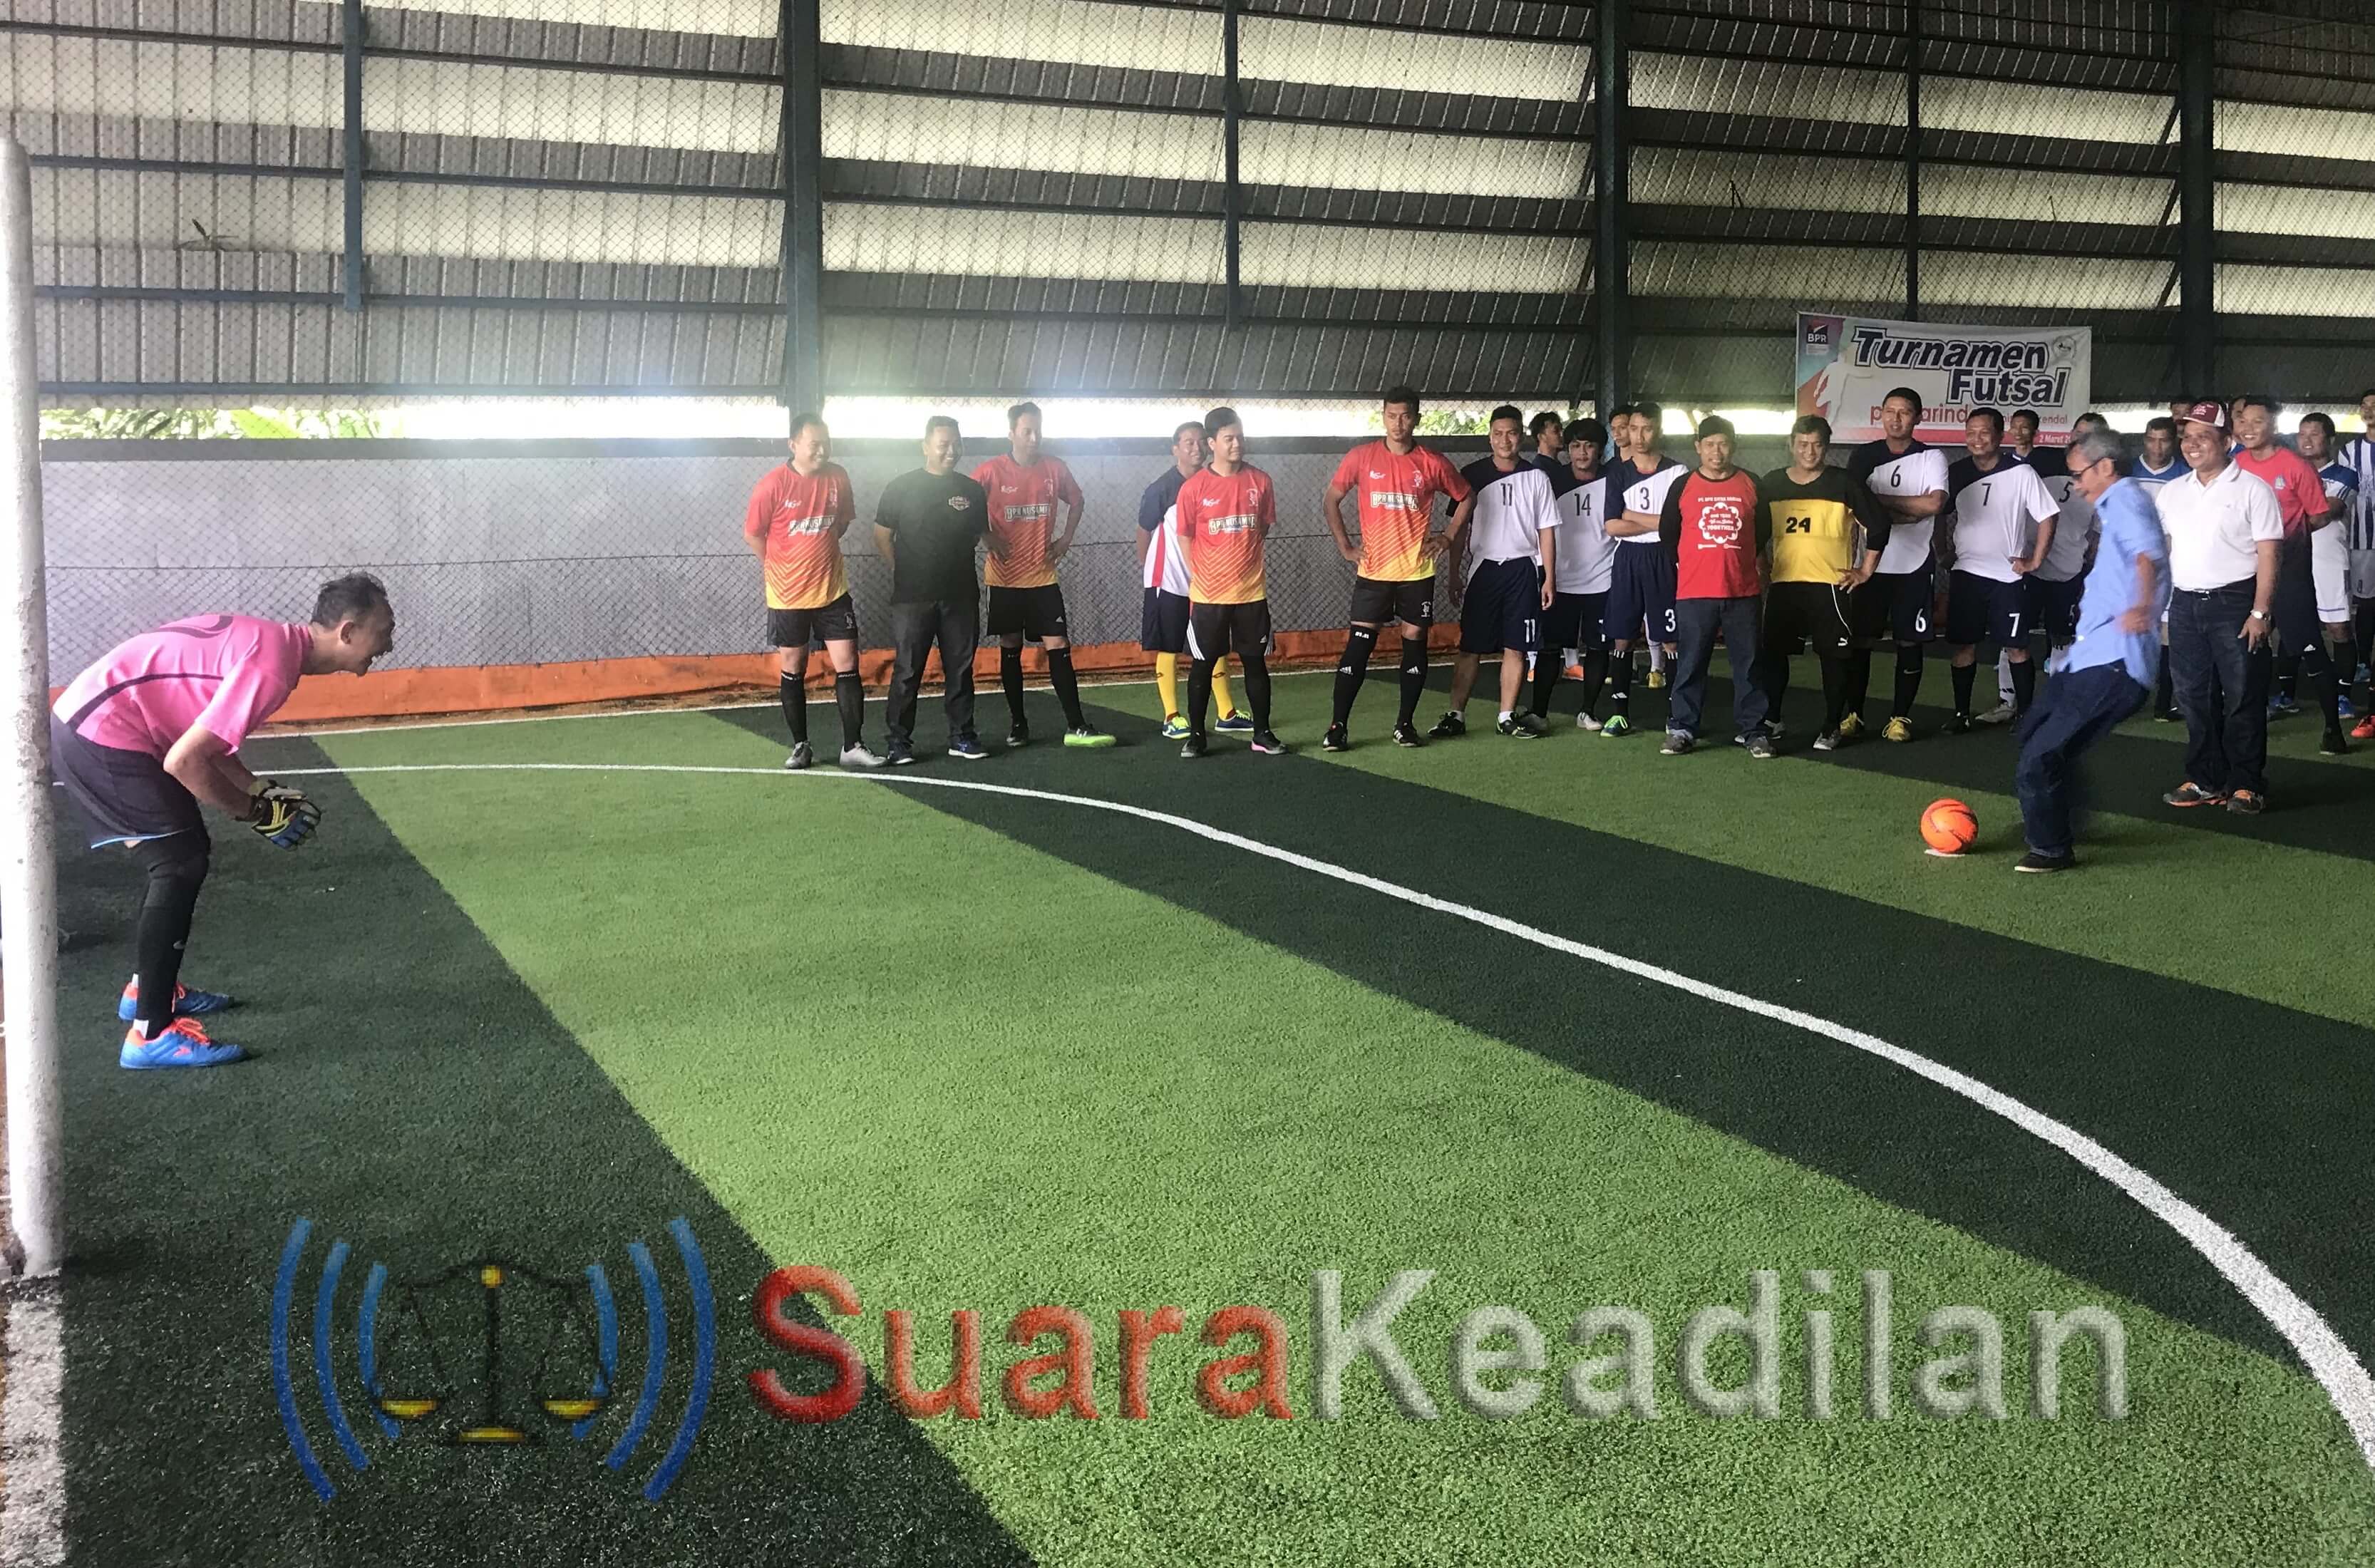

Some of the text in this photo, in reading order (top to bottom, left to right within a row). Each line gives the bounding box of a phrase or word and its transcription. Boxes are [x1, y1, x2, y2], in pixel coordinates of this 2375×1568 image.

[1808, 333, 1827, 342] BPR
[1853, 326, 2049, 372] Turnamen
[1947, 368, 2071, 406] Futsal
[2039, 414, 2068, 423] endal
[1890, 465, 1902, 488] 6
[1500, 483, 1513, 506] 11
[1639, 487, 1650, 510] 3
[1982, 483, 1992, 506] 7
[2059, 481, 2073, 502] 5
[1574, 492, 1592, 517] 14
[1786, 517, 1811, 533] 24
[1524, 619, 1536, 643] 11
[1665, 609, 1676, 632] 3
[1915, 609, 1927, 632] 6
[2009, 612, 2020, 637] 7
